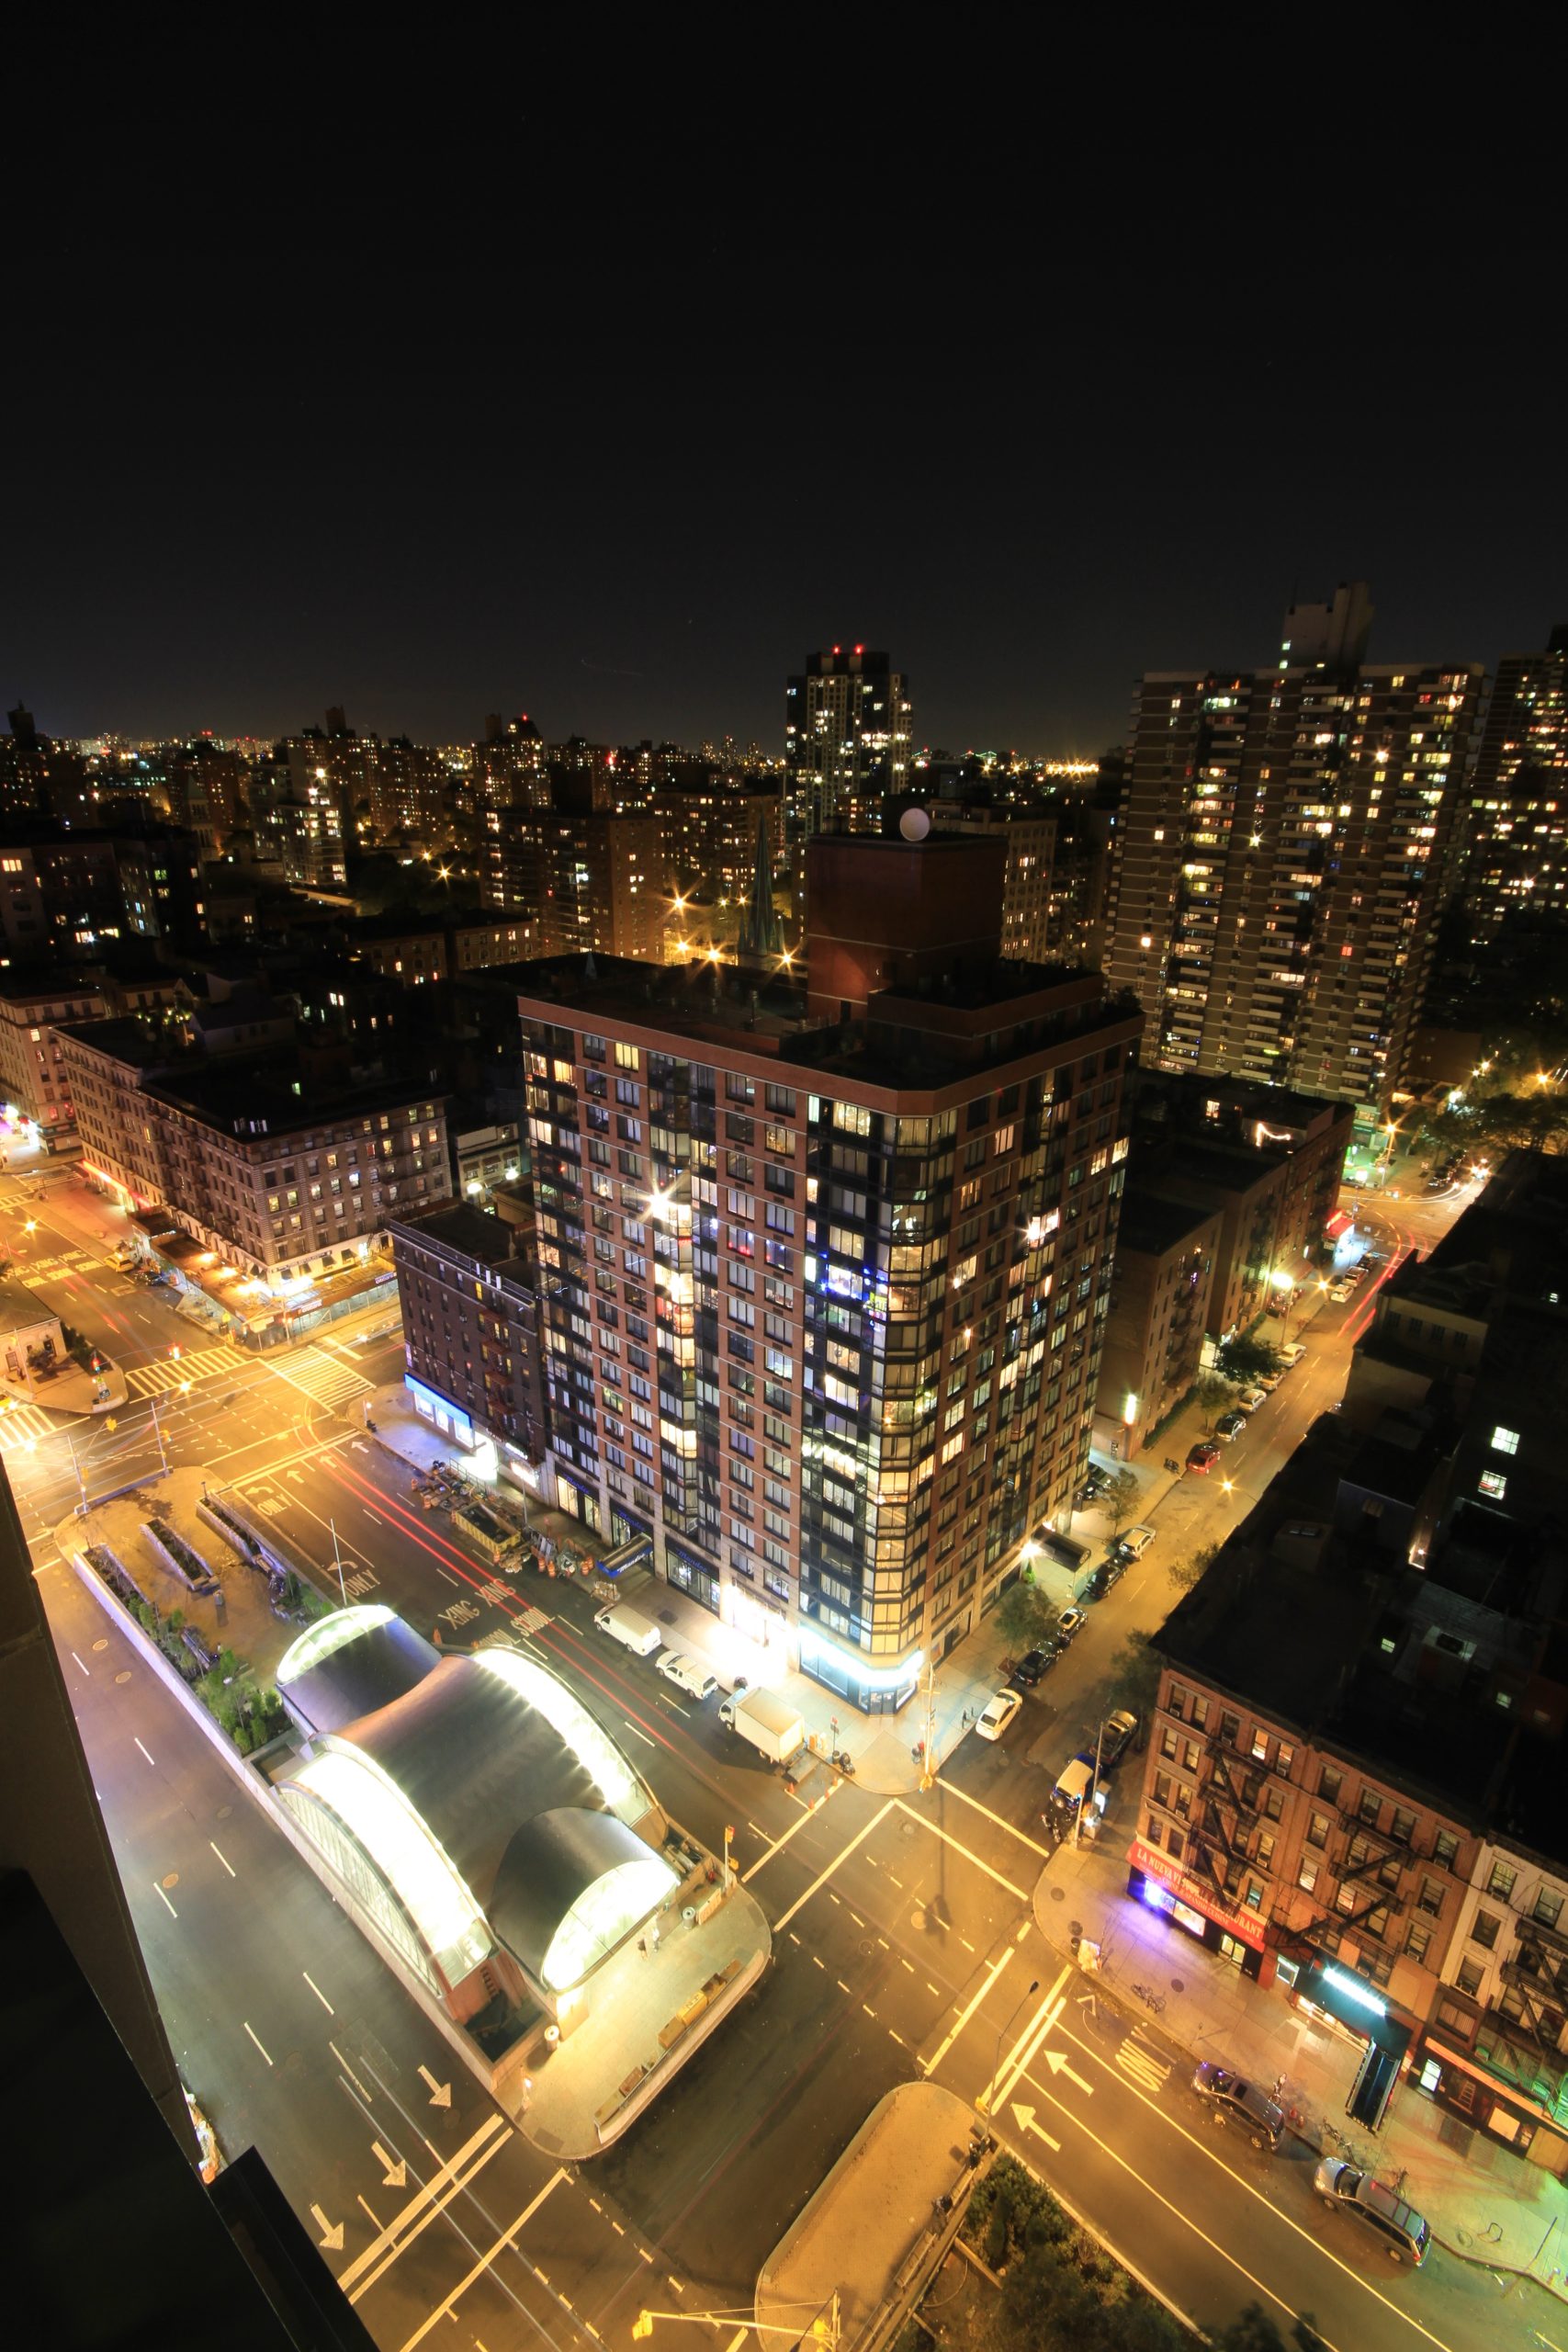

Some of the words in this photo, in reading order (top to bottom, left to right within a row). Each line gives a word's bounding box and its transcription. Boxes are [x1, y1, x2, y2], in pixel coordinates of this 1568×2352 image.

[257, 1493, 292, 1516] ONLY
[344, 1569, 381, 1597] ONLY
[474, 1578, 516, 1608] XING
[437, 1600, 480, 1631] XING
[1137, 1848, 1147, 1863] LA
[1148, 1856, 1173, 1881] NUEVA
[1115, 2025, 1177, 2092] ONLY
